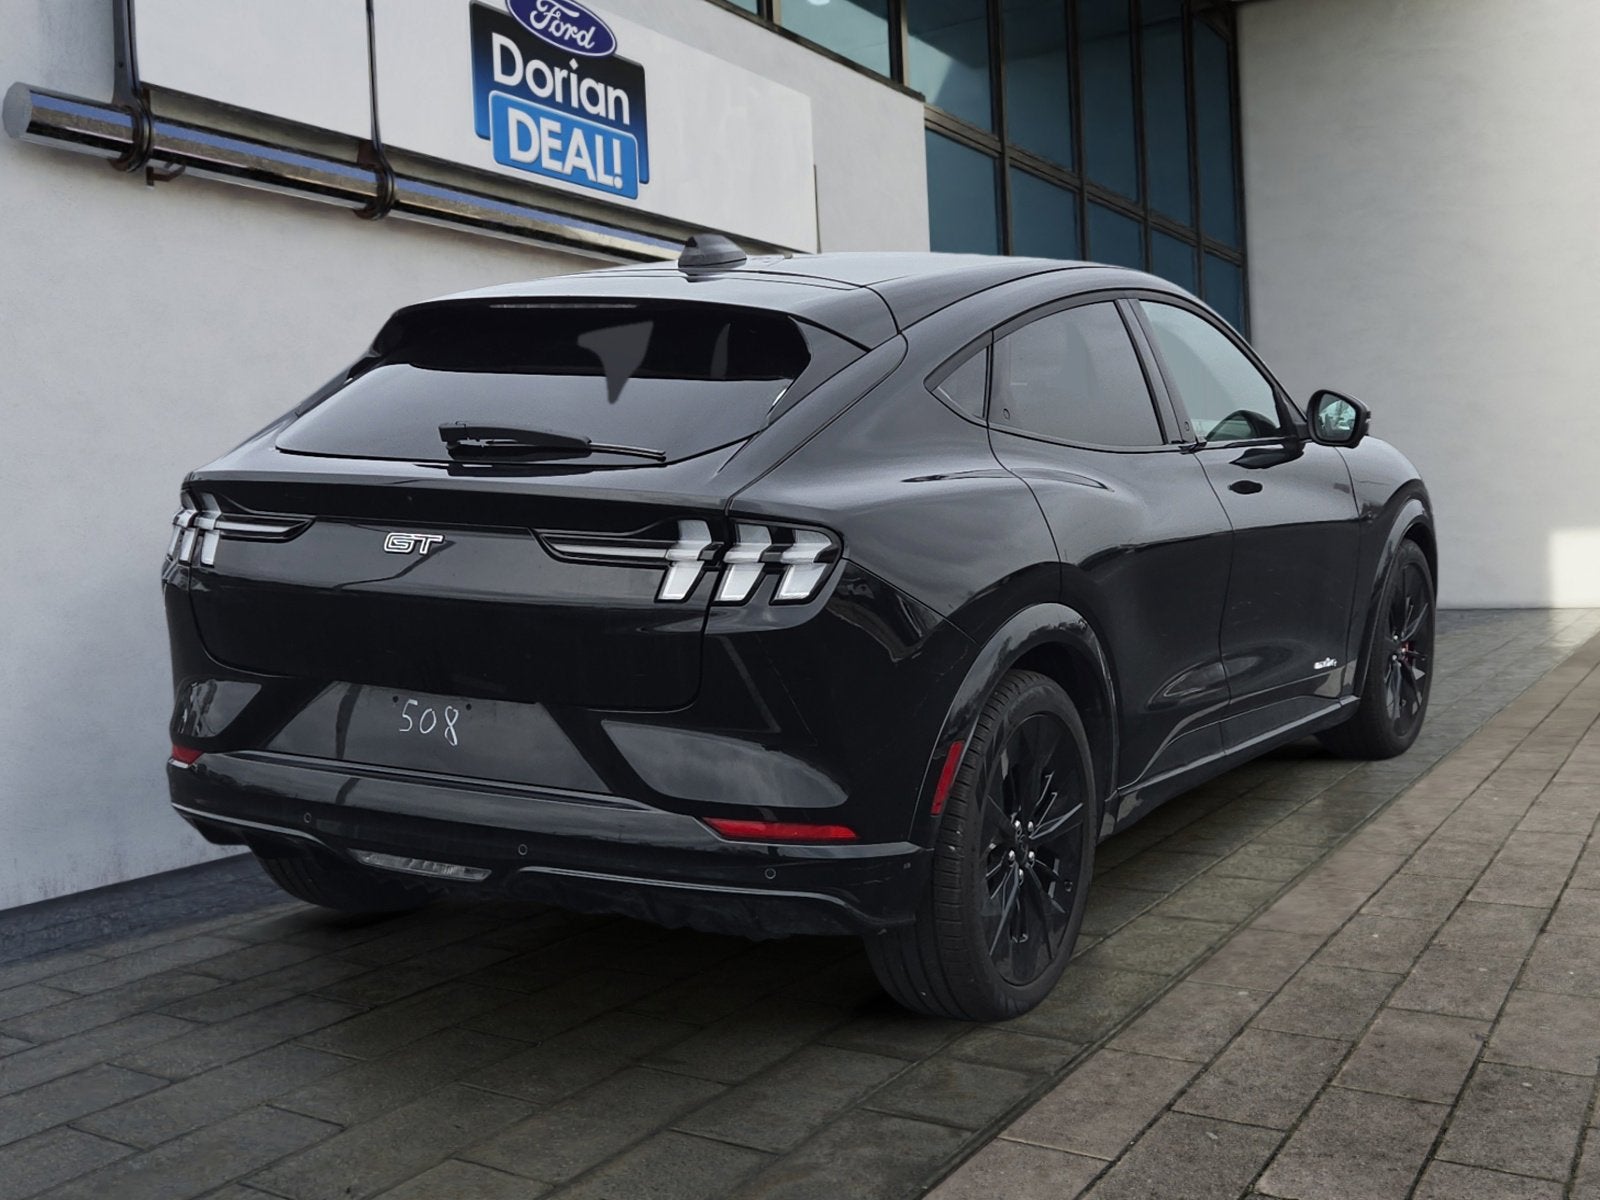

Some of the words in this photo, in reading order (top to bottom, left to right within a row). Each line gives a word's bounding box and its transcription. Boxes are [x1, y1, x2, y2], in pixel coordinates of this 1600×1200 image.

[530, 0, 596, 49] Ford
[492, 32, 630, 126] Dorian
[508, 106, 623, 189] DEAL!
[384, 532, 444, 555] GT
[399, 699, 459, 746] 508
